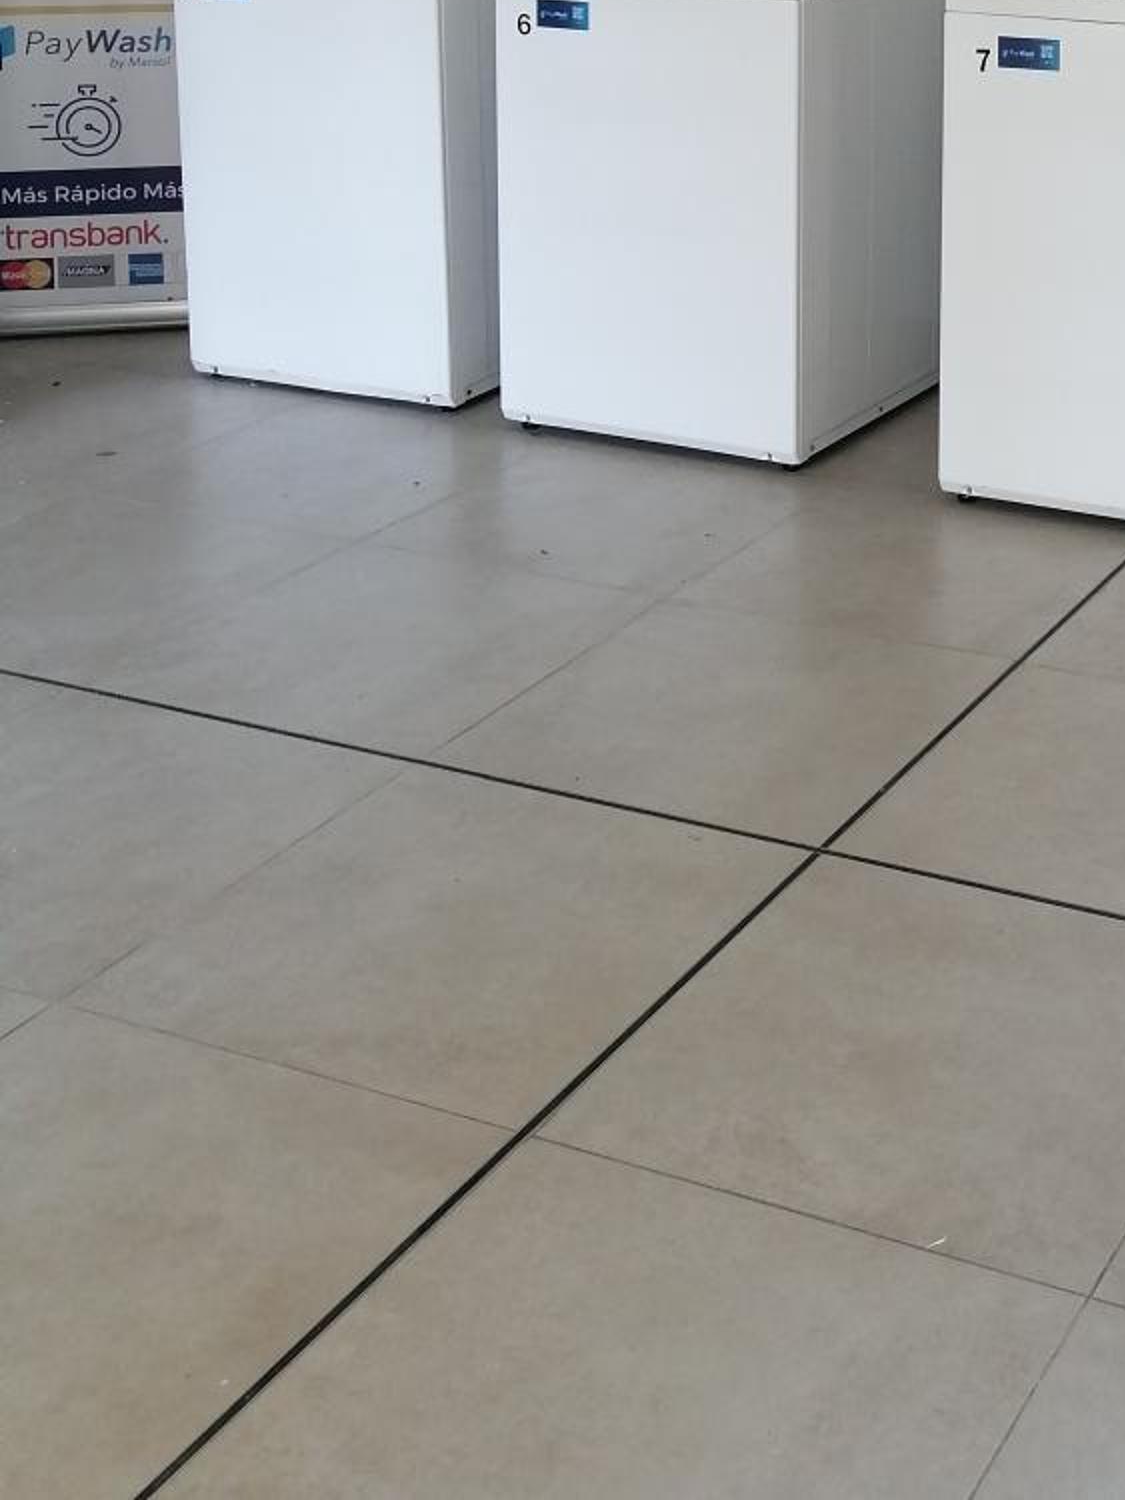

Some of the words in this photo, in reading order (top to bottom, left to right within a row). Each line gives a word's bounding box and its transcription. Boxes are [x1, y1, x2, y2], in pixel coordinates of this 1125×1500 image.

[517, 13, 531, 35] 6
[25, 26, 171, 62] PayWash
[976, 49, 991, 72] 7
[1, 186, 48, 204] Más
[55, 183, 137, 205] Rápido
